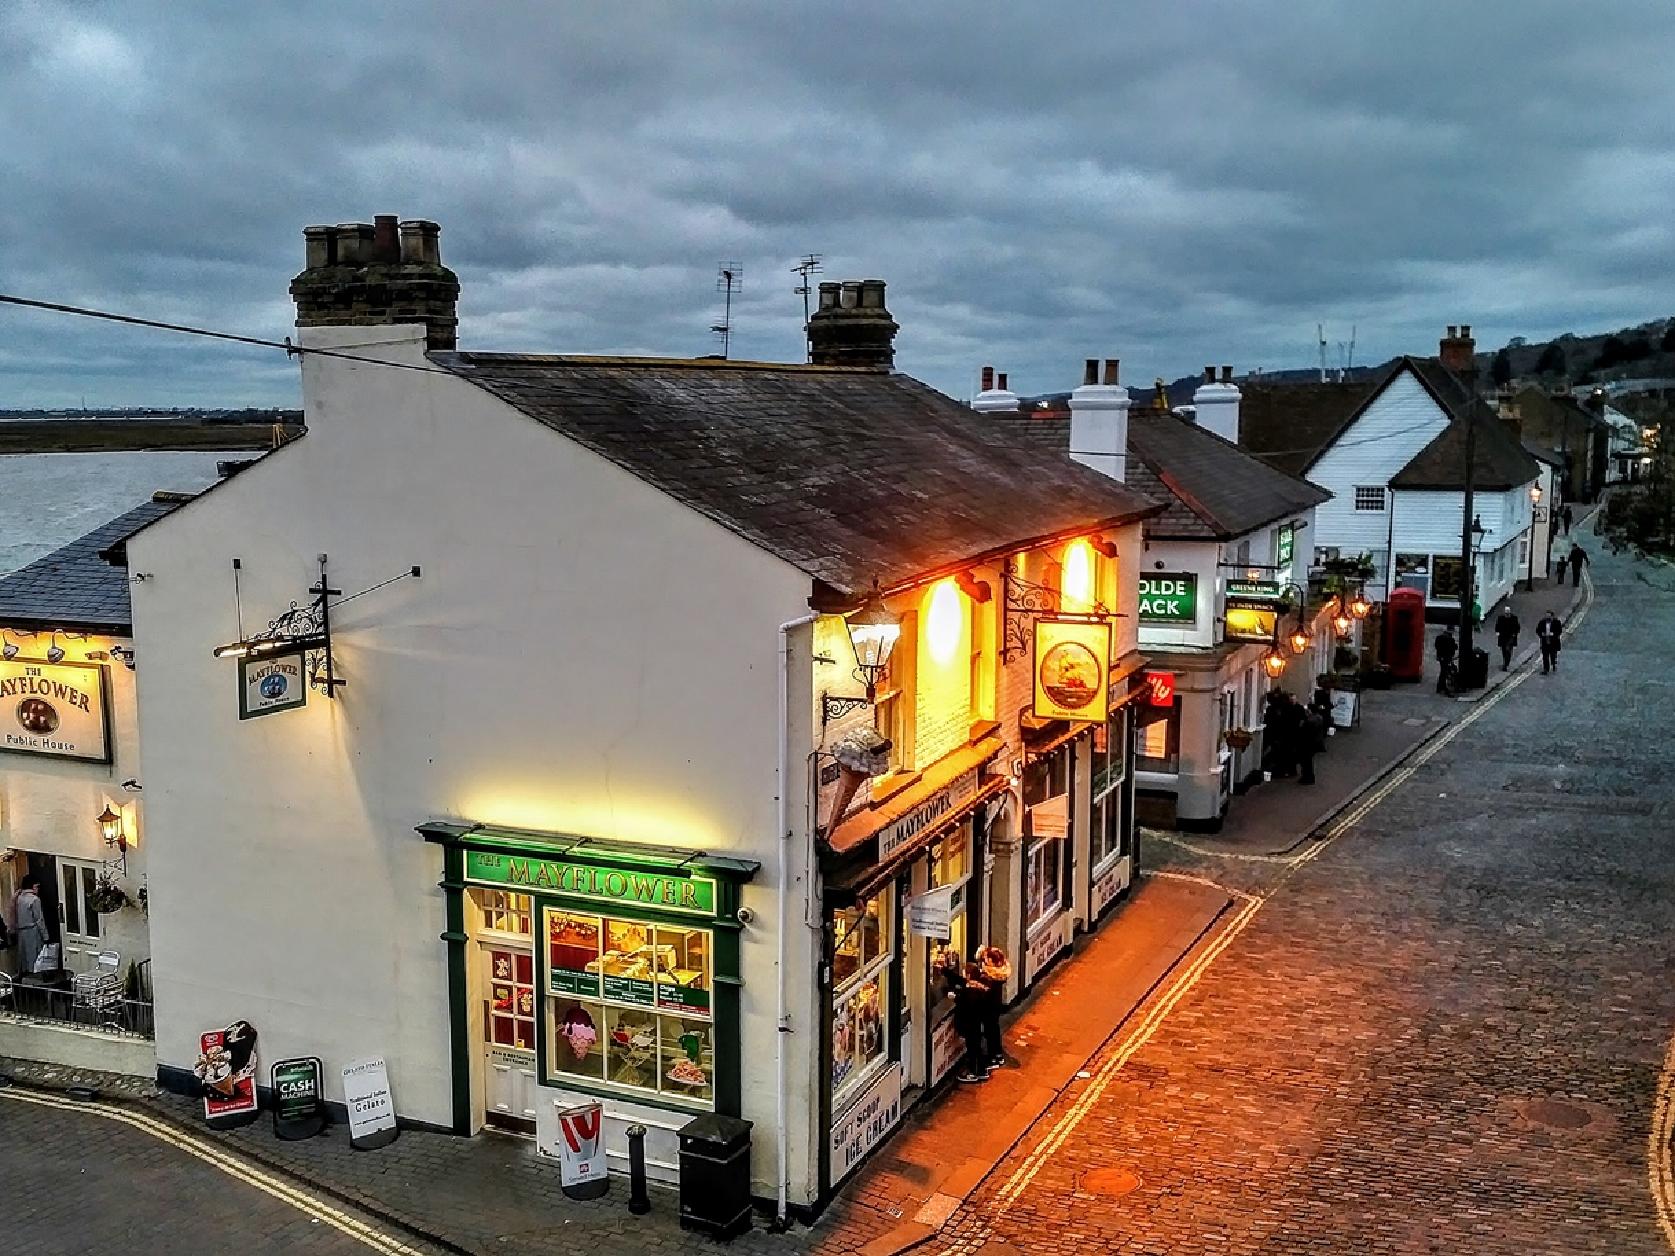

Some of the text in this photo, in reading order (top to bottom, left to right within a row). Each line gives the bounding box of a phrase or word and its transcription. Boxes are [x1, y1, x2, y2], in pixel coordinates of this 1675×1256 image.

[25, 668, 42, 676] THE
[7, 734, 75, 751] Public House
[896, 790, 951, 842] MAYFLOWER
[476, 855, 700, 908] THE MAYFLOWER
[281, 1079, 314, 1093] CASH
[281, 1090, 315, 1100] MACHINE
[845, 1100, 898, 1167] ICE CREAM
